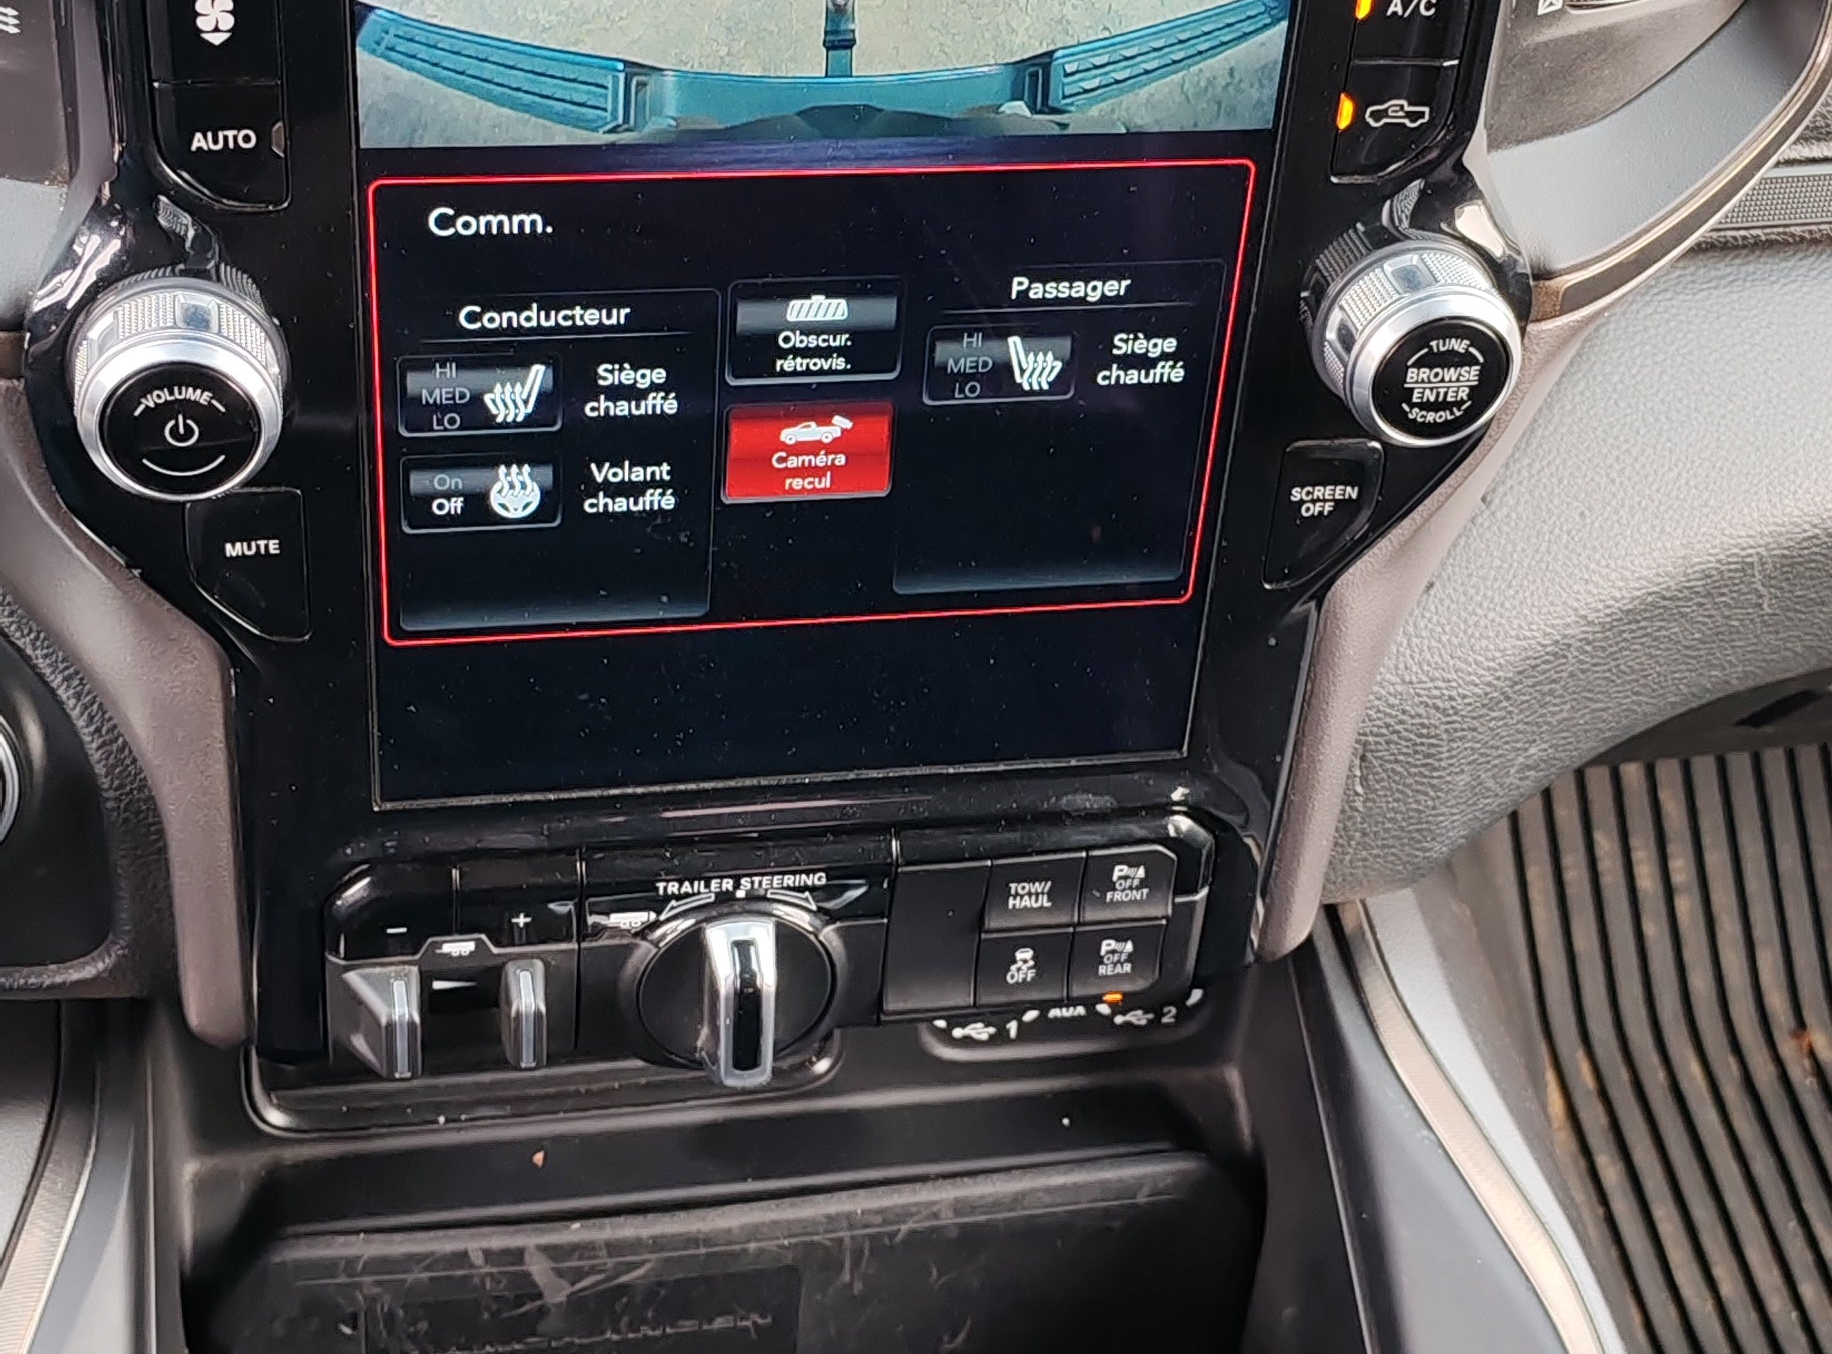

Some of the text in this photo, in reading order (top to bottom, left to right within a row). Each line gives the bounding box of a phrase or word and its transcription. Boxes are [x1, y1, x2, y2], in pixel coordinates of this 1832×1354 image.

[190, 129, 257, 151] AUTO
[428, 207, 553, 237] Comm.
[1010, 276, 1131, 302] Passager
[458, 302, 631, 330] Conducteur
[777, 330, 852, 348] Obscur.
[962, 332, 983, 348] HI
[1111, 333, 1178, 357] Siège
[1429, 337, 1471, 353] TUNE
[434, 362, 457, 378] HI
[775, 353, 852, 372] rétrovis.
[946, 356, 993, 375] MED
[596, 362, 667, 387] Siège
[1096, 361, 1185, 386] chauffé
[1405, 365, 1481, 383] BROWSE
[140, 386, 214, 408] VOLUME
[421, 387, 470, 405] MED
[954, 381, 981, 398] LO
[1412, 387, 1470, 403] ENTER
[584, 392, 678, 418] chauffé
[432, 412, 461, 430] LO
[1408, 406, 1464, 423] SCROLL
[771, 451, 846, 469] Caméra
[590, 460, 671, 484] Volant
[785, 472, 831, 490] recul
[433, 474, 463, 491] On
[583, 488, 676, 513] chauffé
[1290, 486, 1359, 501] SCREEN
[431, 497, 464, 515] Off
[1301, 502, 1334, 517] OFF
[224, 539, 281, 558] MUTE
[656, 872, 827, 895] TRAILER STEERING
[1009, 880, 1052, 894] TOW/
[1115, 878, 1140, 890] OFF
[1008, 894, 1052, 909] HAUL
[1106, 888, 1150, 902] FRONT
[1103, 952, 1129, 964] OFF
[1006, 969, 1036, 984] OFF
[1098, 962, 1132, 976] REAR
[1161, 1006, 1177, 1024] 2
[1005, 1020, 1018, 1039] 1
